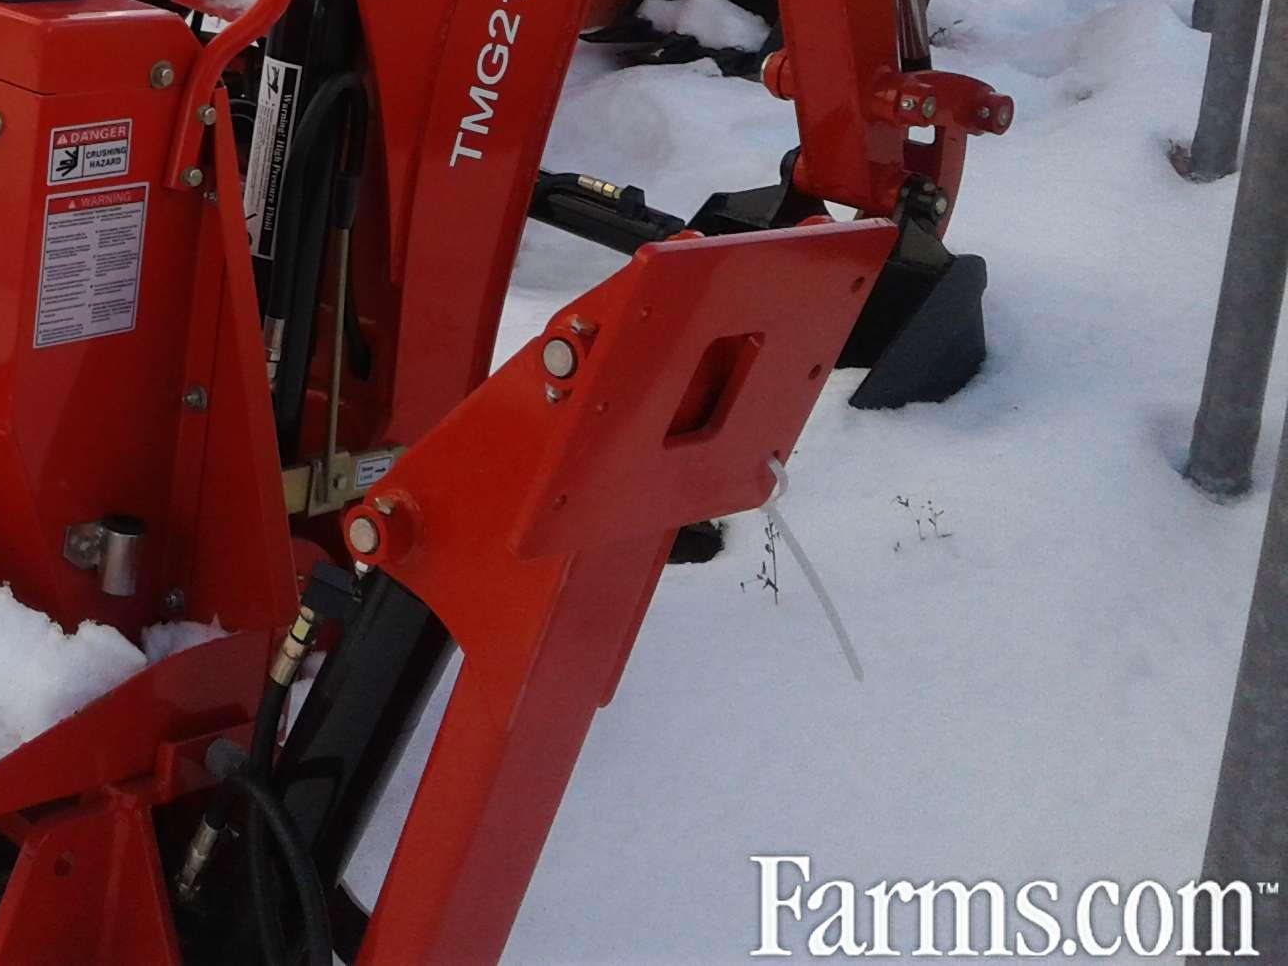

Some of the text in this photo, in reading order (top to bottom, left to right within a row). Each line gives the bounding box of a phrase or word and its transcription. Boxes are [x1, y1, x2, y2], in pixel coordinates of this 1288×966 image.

[70, 126, 127, 144] DANGER
[86, 146, 127, 159] CRUSHING
[90, 157, 122, 168] HAZARD
[81, 190, 133, 207] WARNING
